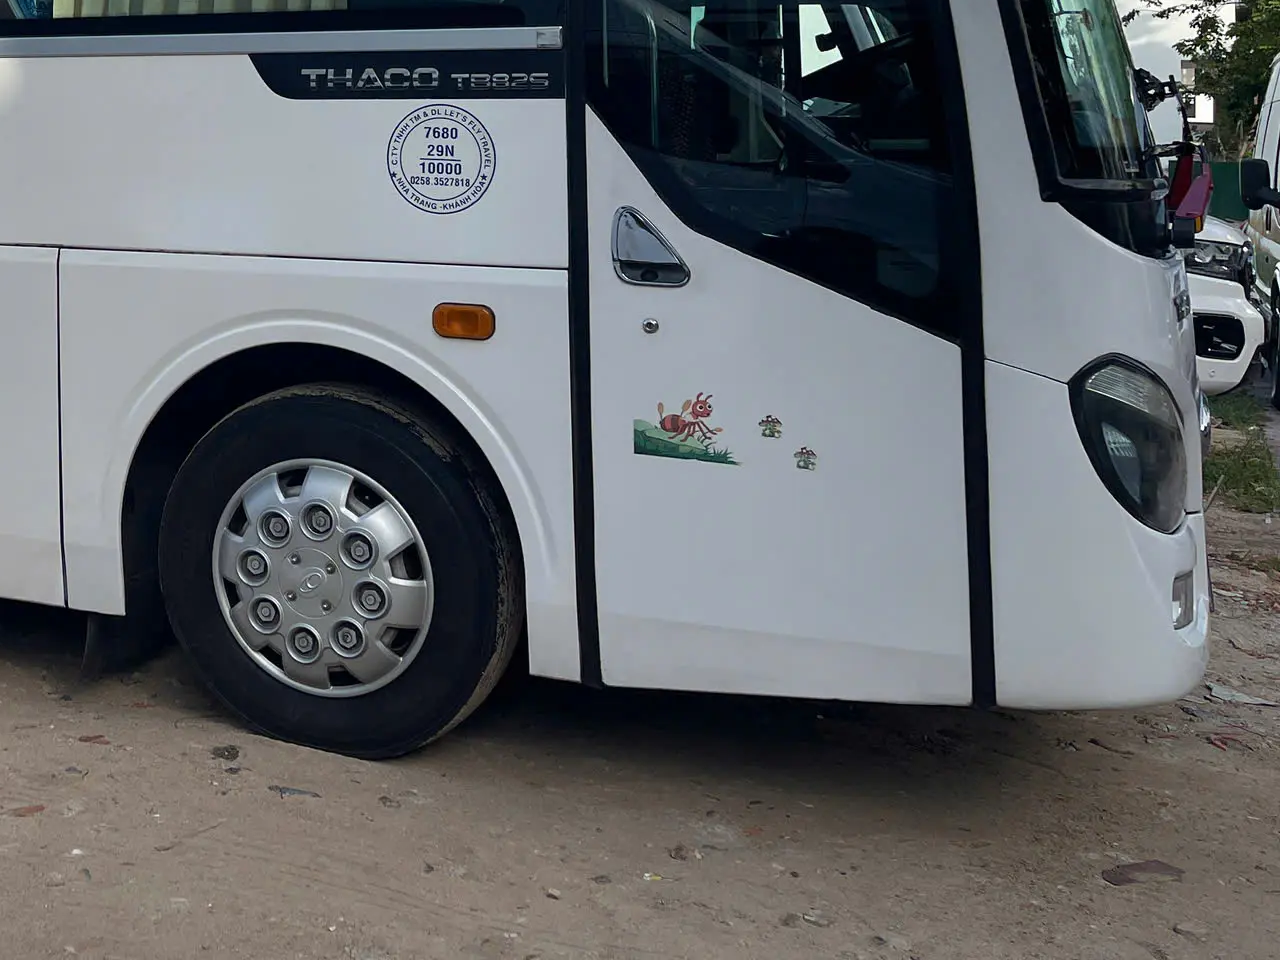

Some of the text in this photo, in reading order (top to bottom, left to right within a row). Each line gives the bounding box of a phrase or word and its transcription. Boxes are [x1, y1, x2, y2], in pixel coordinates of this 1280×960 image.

[300, 67, 439, 89] THACO
[394, 122, 410, 144] TNHH
[409, 114, 421, 123] TM
[444, 108, 468, 122] LET'S
[467, 120, 482, 135] FLY
[480, 136, 491, 169] TRAVEL
[423, 126, 458, 140] 7680
[427, 144, 455, 157] 29N
[419, 161, 462, 176] 10000
[410, 175, 470, 188] 0258.3527818
[396, 177, 410, 195] NHA
[410, 192, 437, 210] TRANG
